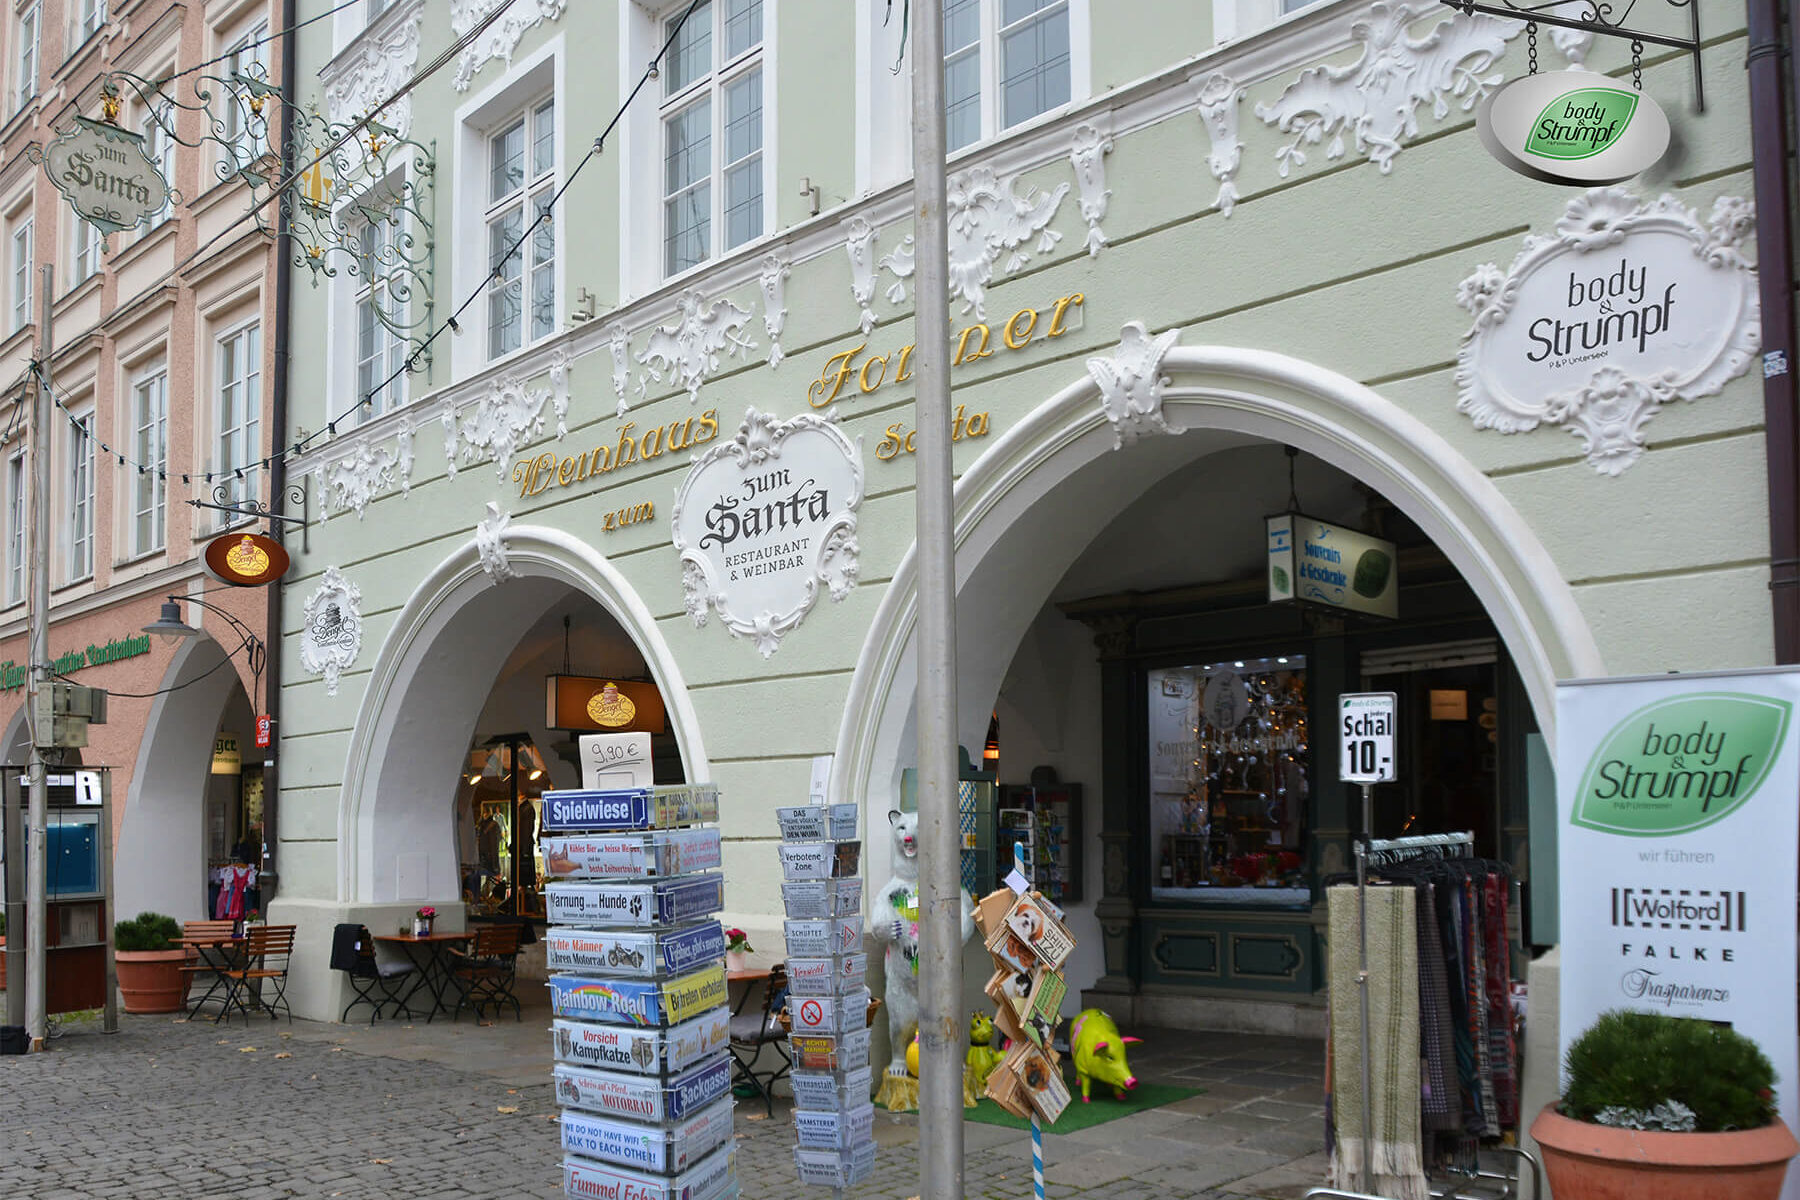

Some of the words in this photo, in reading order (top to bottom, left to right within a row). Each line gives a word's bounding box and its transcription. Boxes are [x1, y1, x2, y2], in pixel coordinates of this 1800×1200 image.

[1564, 101, 1606, 125] body
[1537, 119, 1618, 149] Strumpf
[96, 143, 127, 165] zum
[63, 149, 151, 206] Santa
[1568, 259, 1646, 307] body
[1599, 299, 1613, 314] &
[1527, 283, 1677, 362] Strumpf
[808, 292, 1085, 409] Forner
[512, 408, 718, 498] Weinhaus
[741, 465, 792, 501] zum
[601, 499, 654, 533] zum
[699, 477, 831, 552] Santa
[724, 536, 810, 568] RESTAURANT
[730, 569, 741, 581] &
[742, 555, 805, 579] WEINBAR
[1344, 712, 1391, 737] Schal
[628, 743, 639, 756] €
[1643, 721, 1726, 766] body
[1348, 741, 1391, 778] 10,-
[1671, 756, 1686, 769] &
[1595, 754, 1752, 812] Strumpf
[553, 800, 630, 824] Spielwiese
[793, 809, 806, 817] DAS
[586, 843, 597, 853] Bier
[785, 852, 821, 861] Verbotene
[1639, 850, 1660, 862] wir
[1664, 849, 1715, 863] führen
[795, 862, 812, 871] Zone
[599, 893, 626, 909] Hunde
[1633, 898, 1720, 922] Wolford
[572, 938, 603, 952] Männer
[1045, 928, 1067, 954] SHIH
[1623, 943, 1734, 962] FALKE
[573, 953, 606, 967] Motorrad
[556, 986, 608, 1014] Rainbow
[611, 993, 647, 1016] Road
[583, 1030, 619, 1045] Vorsicht
[572, 1042, 631, 1065] Kampfkatze
[680, 1067, 730, 1106] Sackgasse
[601, 1094, 654, 1116] MOTORRAD
[575, 1124, 586, 1134] DO
[588, 1126, 602, 1138] NOT
[604, 1129, 622, 1142] HAVE
[624, 1133, 640, 1145] WIFI
[586, 1138, 596, 1150] TO
[599, 1142, 621, 1156] EACH
